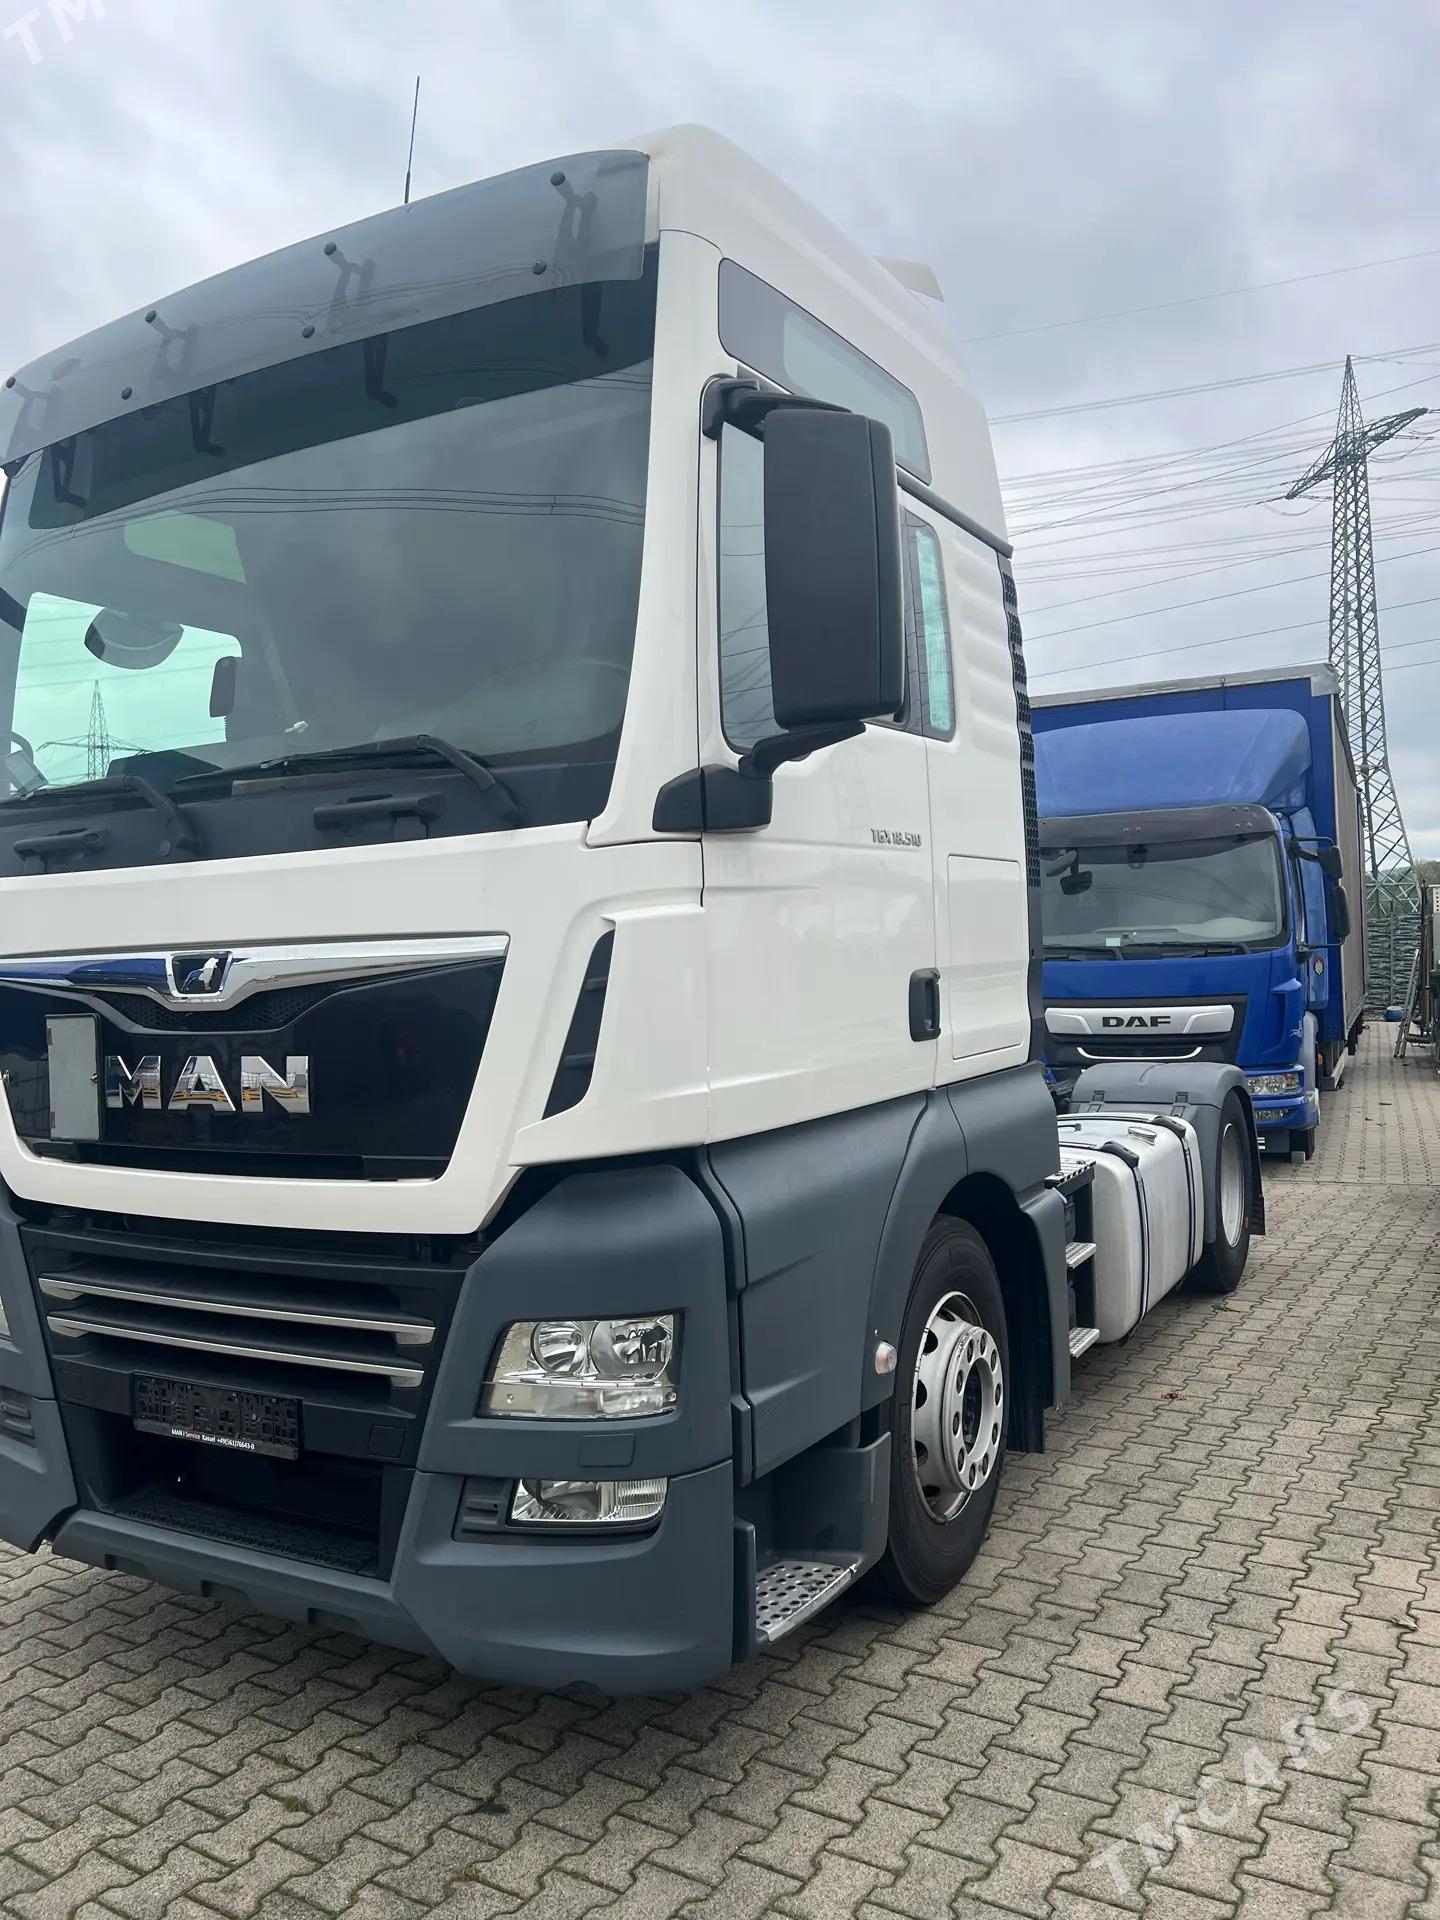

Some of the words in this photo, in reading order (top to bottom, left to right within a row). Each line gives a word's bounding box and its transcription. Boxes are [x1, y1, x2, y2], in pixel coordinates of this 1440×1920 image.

[870, 828, 891, 844] TGX
[1102, 1016, 1171, 1028] DAF
[105, 1055, 311, 1114] MAN
[171, 1428, 183, 1436] MAN
[185, 1431, 201, 1440] Service
